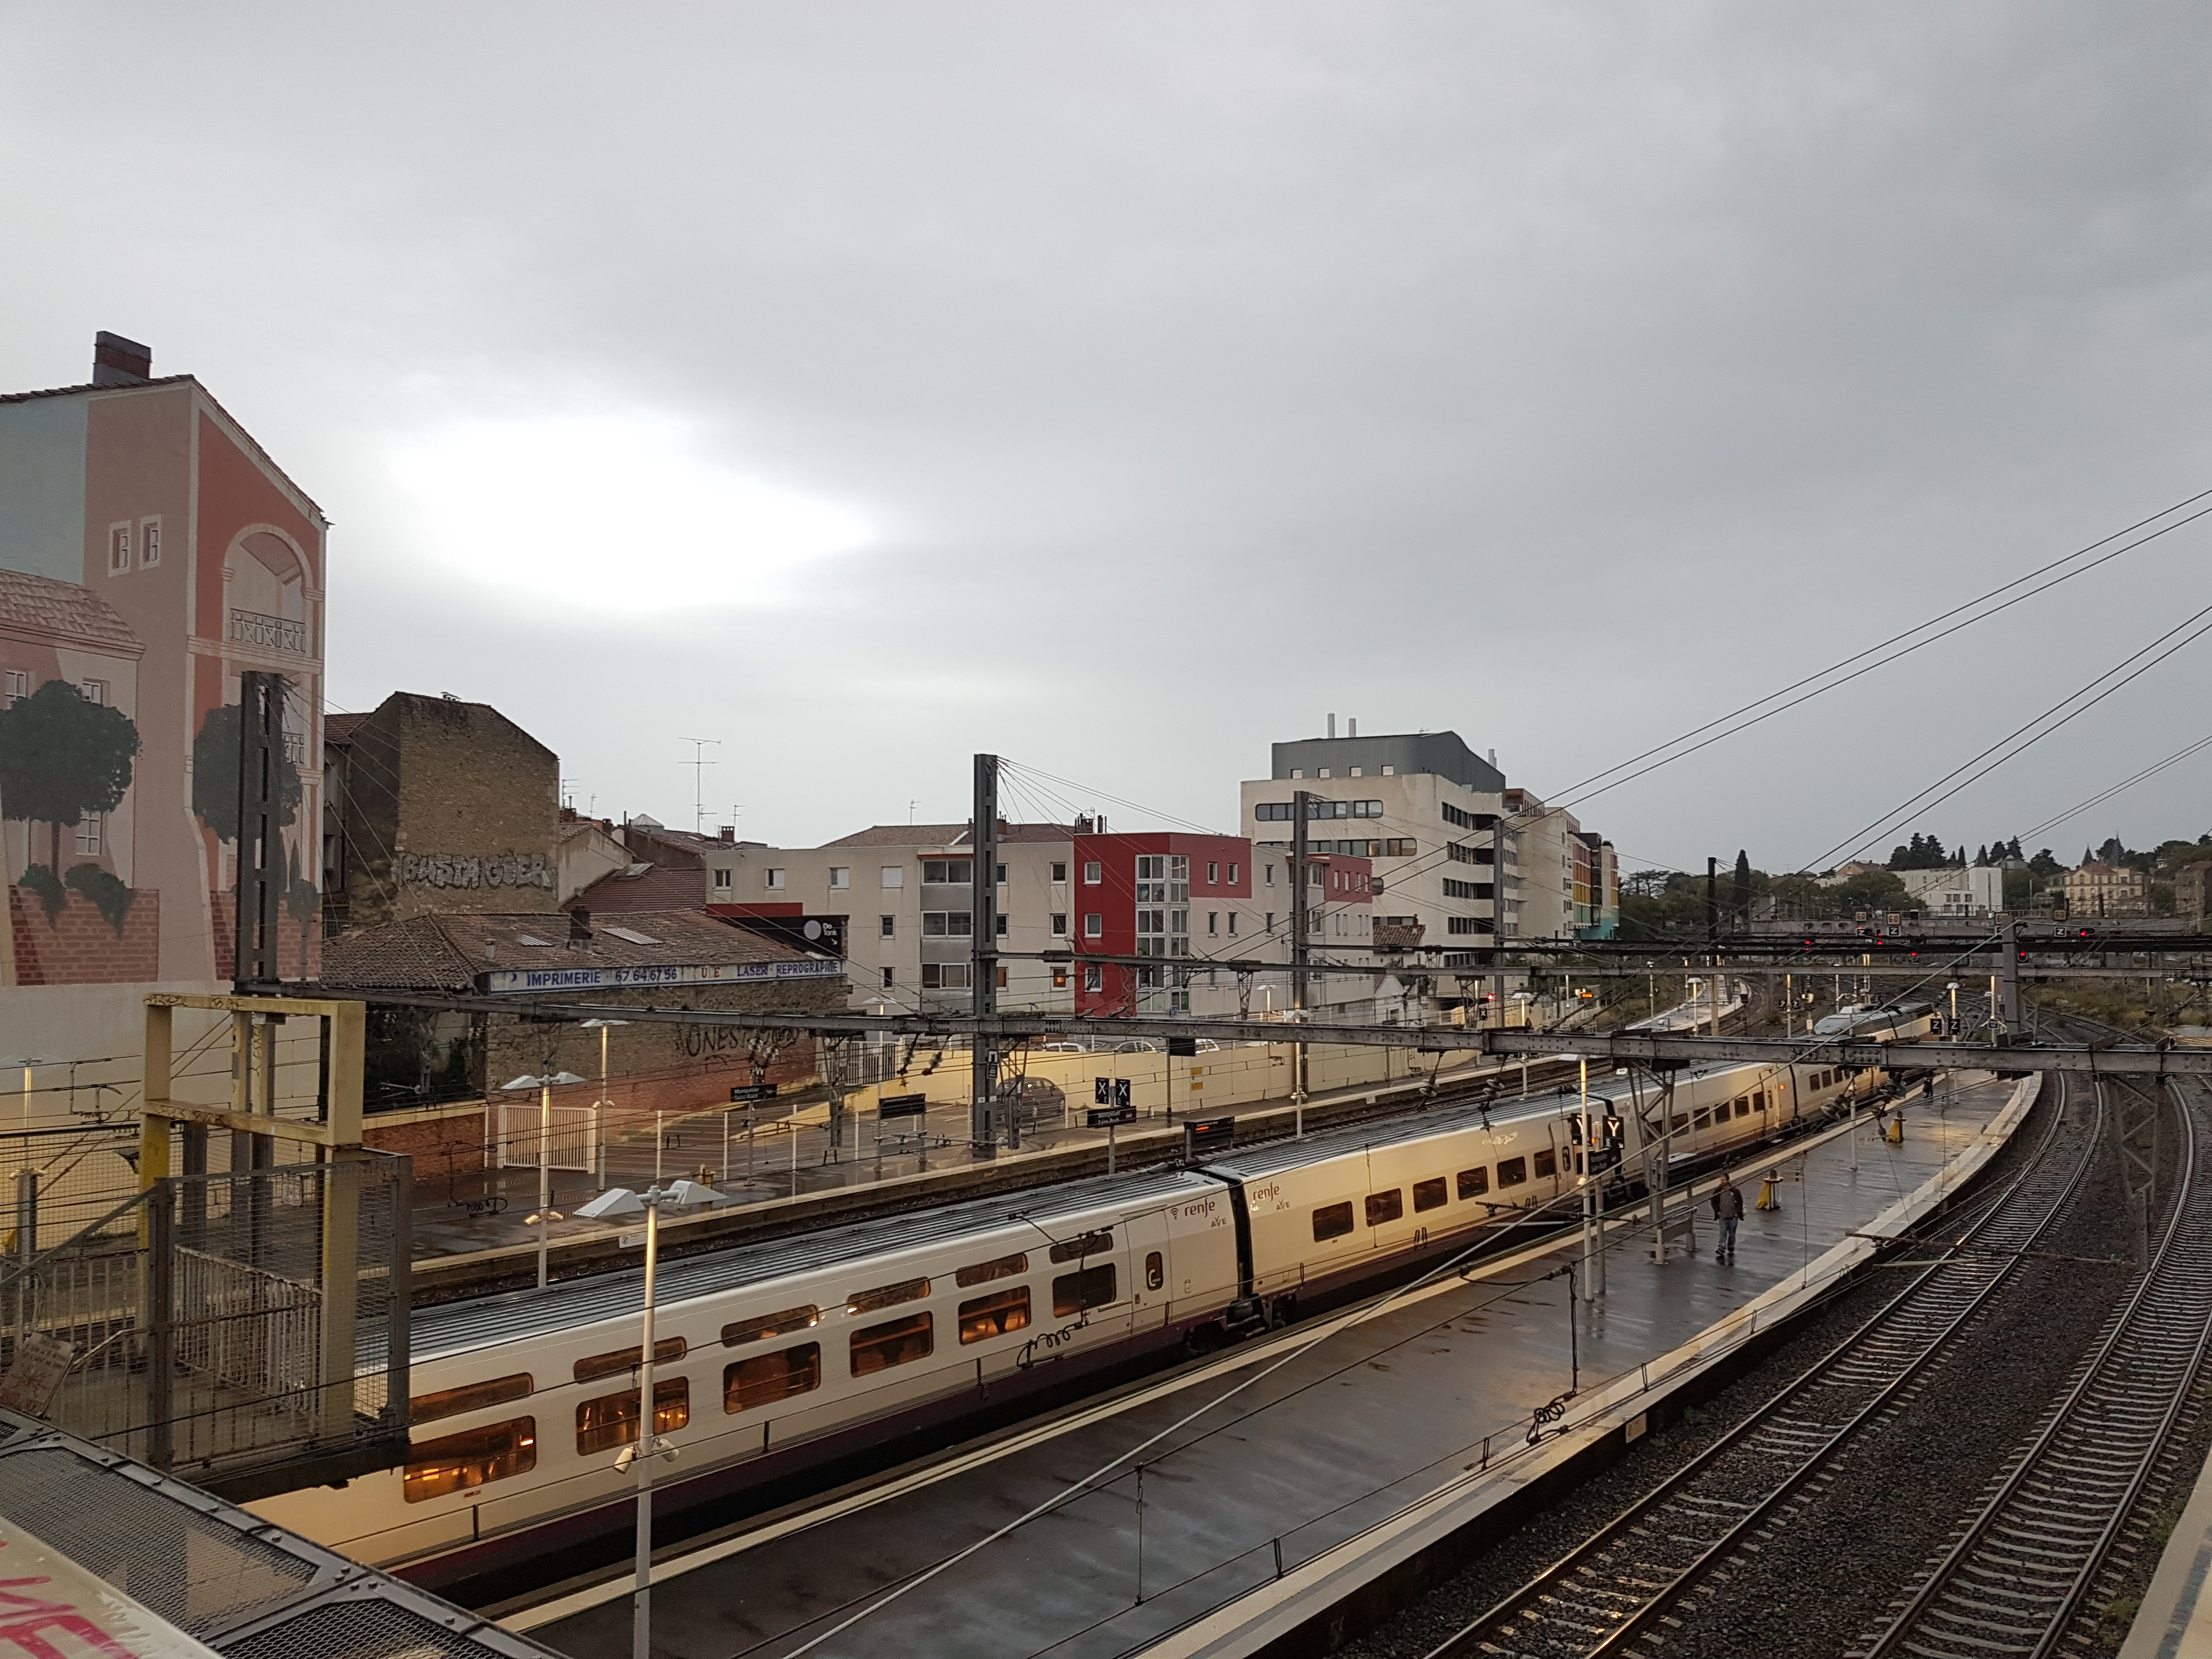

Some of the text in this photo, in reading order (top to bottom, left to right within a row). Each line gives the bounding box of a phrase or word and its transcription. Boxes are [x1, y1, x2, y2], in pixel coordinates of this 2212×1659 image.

[527, 971, 601, 986] IMPRIMERIE
[615, 968, 678, 983] 67.64.67.56
[737, 963, 768, 977] LASER
[776, 962, 838, 975] REPROGRAPHIE
[1932, 1021, 1940, 1029] Z
[1950, 1021, 1958, 1030] Z
[1098, 1081, 1107, 1094] X
[1119, 1083, 1127, 1096] X
[1607, 1121, 1620, 1137] Y
[1252, 1182, 1280, 1202] renfe
[1184, 1197, 1216, 1218] renfe
[1276, 1198, 1291, 1211] AVE
[1210, 1215, 1228, 1228] AVE
